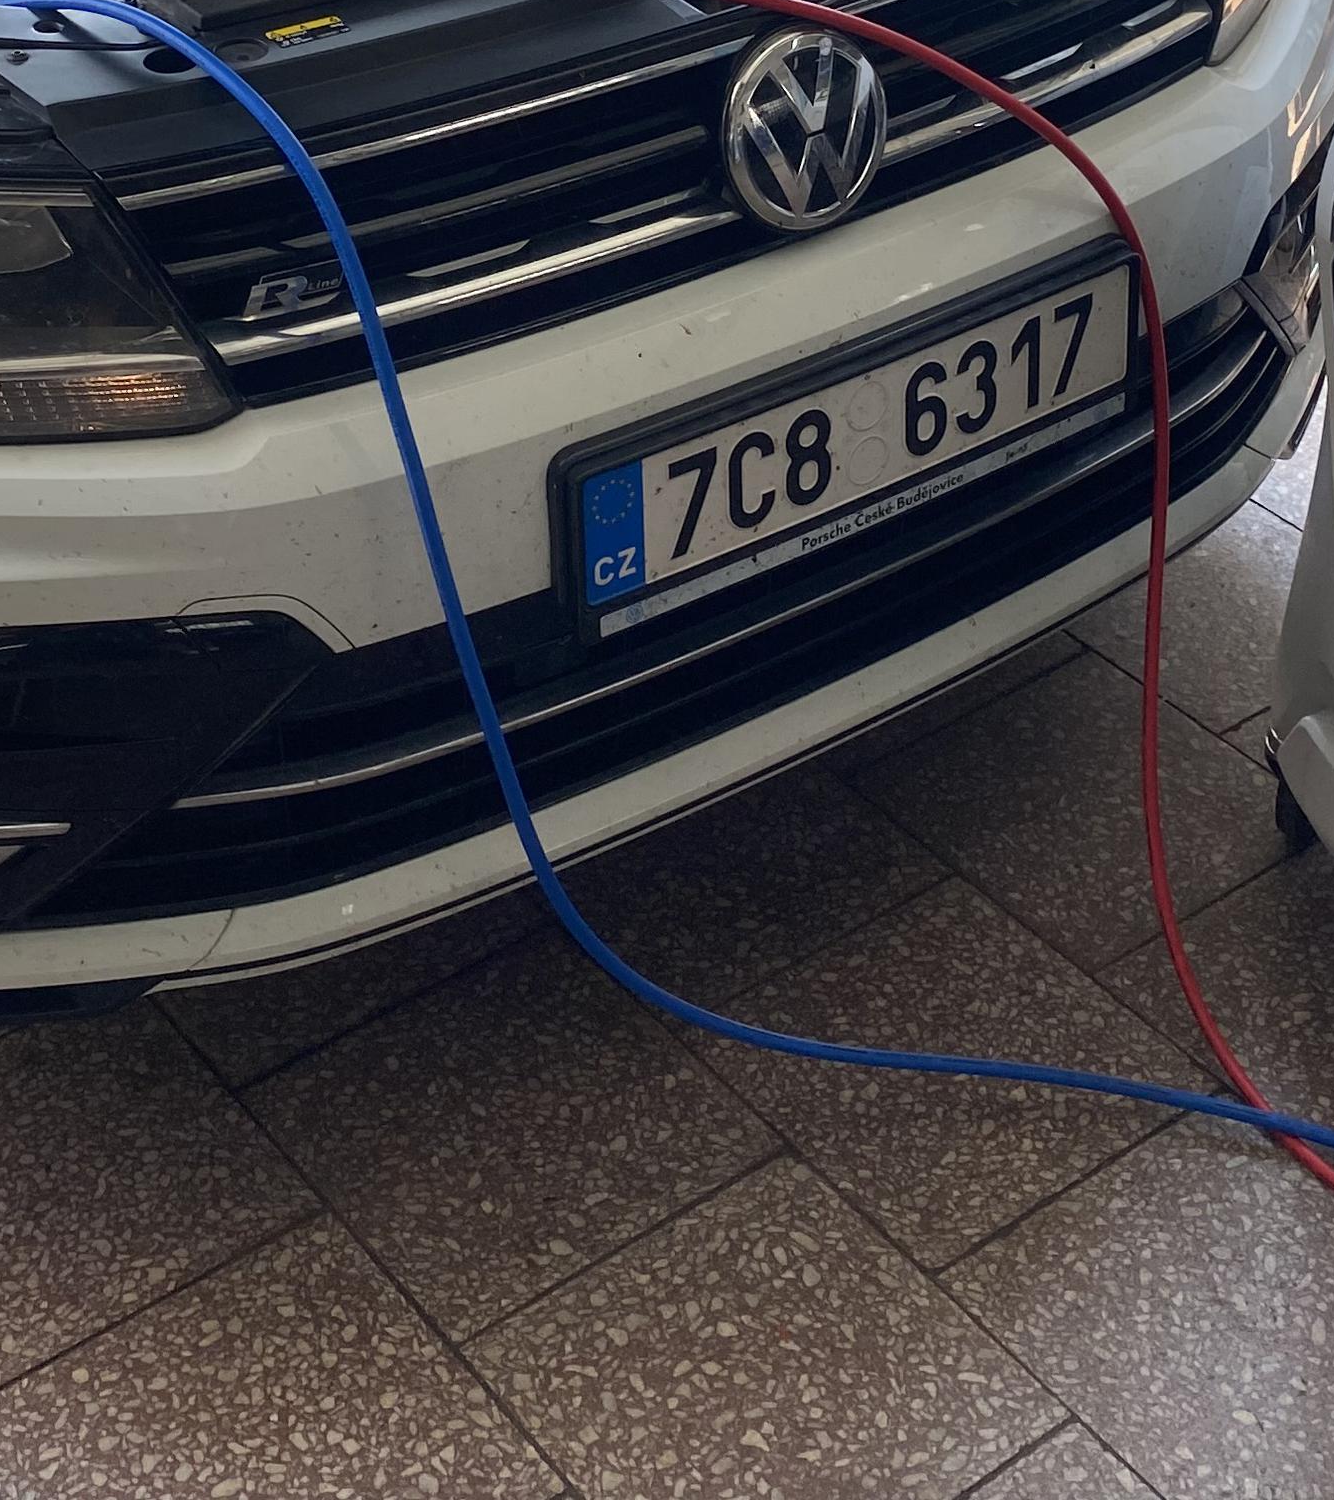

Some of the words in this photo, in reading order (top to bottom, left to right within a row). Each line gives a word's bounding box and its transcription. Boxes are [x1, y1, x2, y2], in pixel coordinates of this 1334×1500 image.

[668, 408, 832, 560] 7C8
[904, 292, 1094, 457] 6317
[801, 522, 852, 551] Porsche
[854, 501, 895, 528] České
[897, 472, 964, 510] Budějovice
[594, 546, 637, 586] CZ
